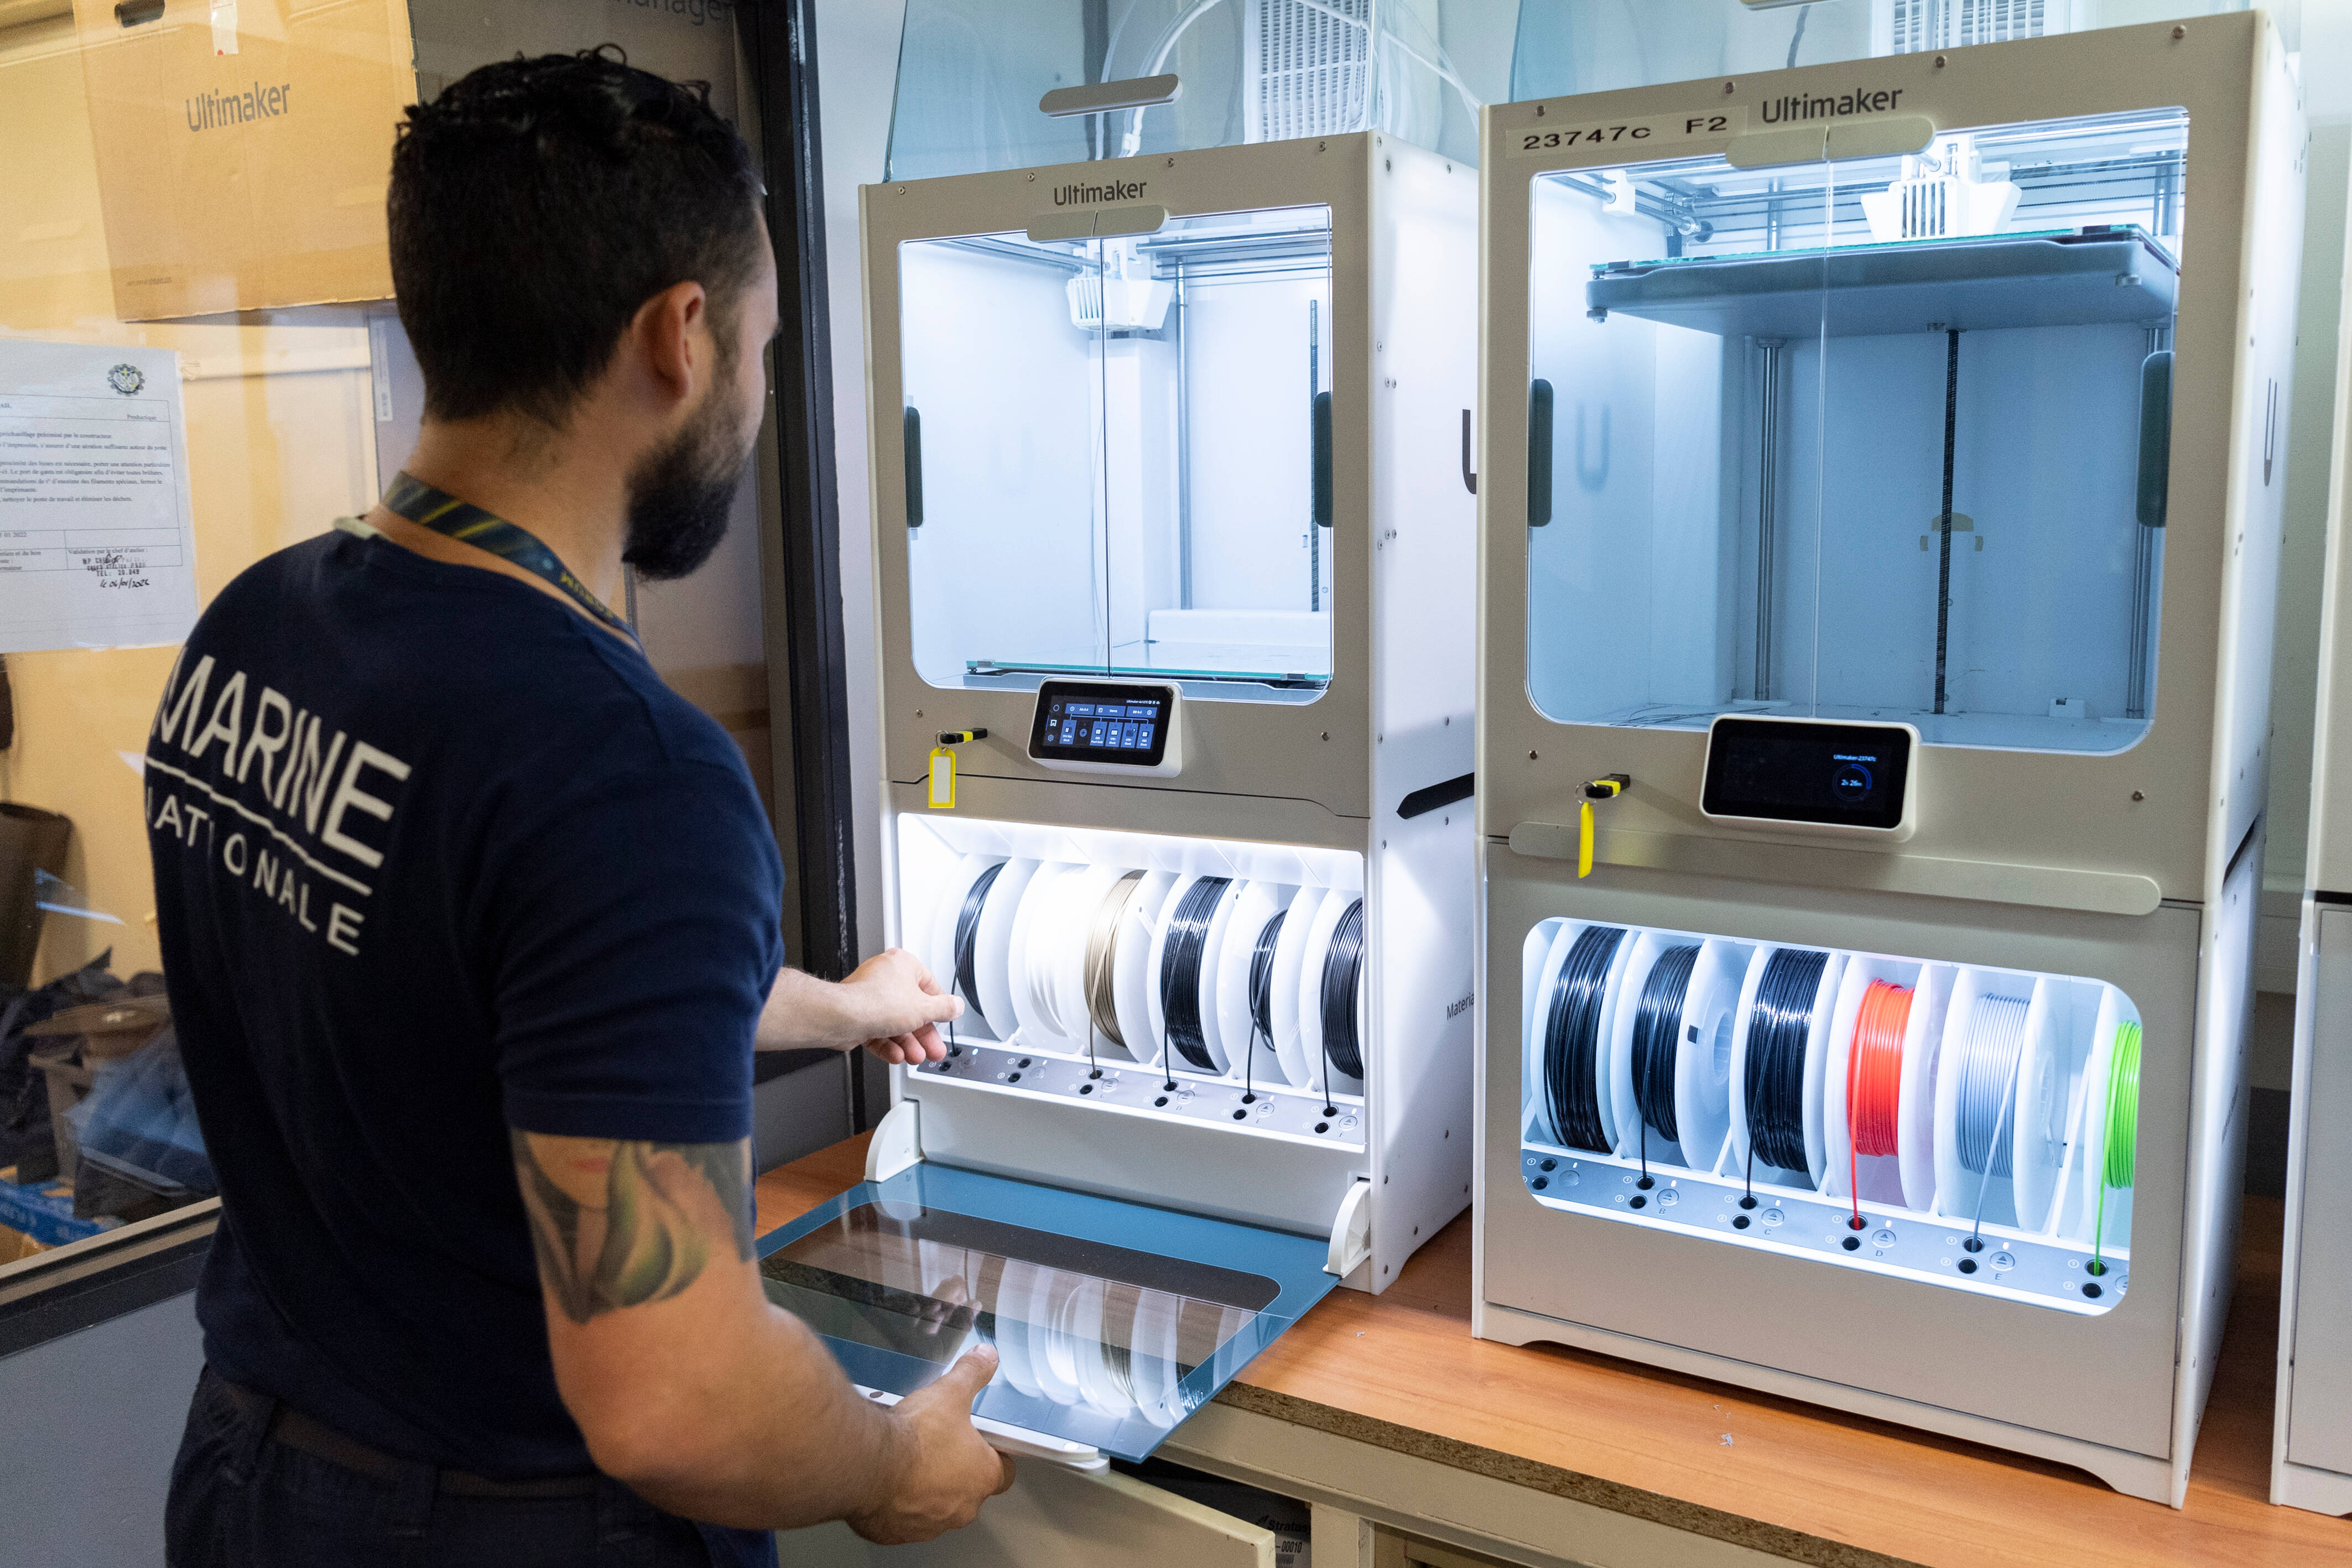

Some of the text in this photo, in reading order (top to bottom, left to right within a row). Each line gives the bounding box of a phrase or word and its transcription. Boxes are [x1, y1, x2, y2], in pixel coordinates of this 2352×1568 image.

[186, 81, 290, 132] Ultimaker
[1762, 87, 1903, 124] Ultimaker
[1523, 116, 1727, 150] 23747c F2
[1054, 180, 1147, 206] Ultimaker
[152, 646, 412, 868] MARINE
[1447, 992, 1474, 1020] Materia
